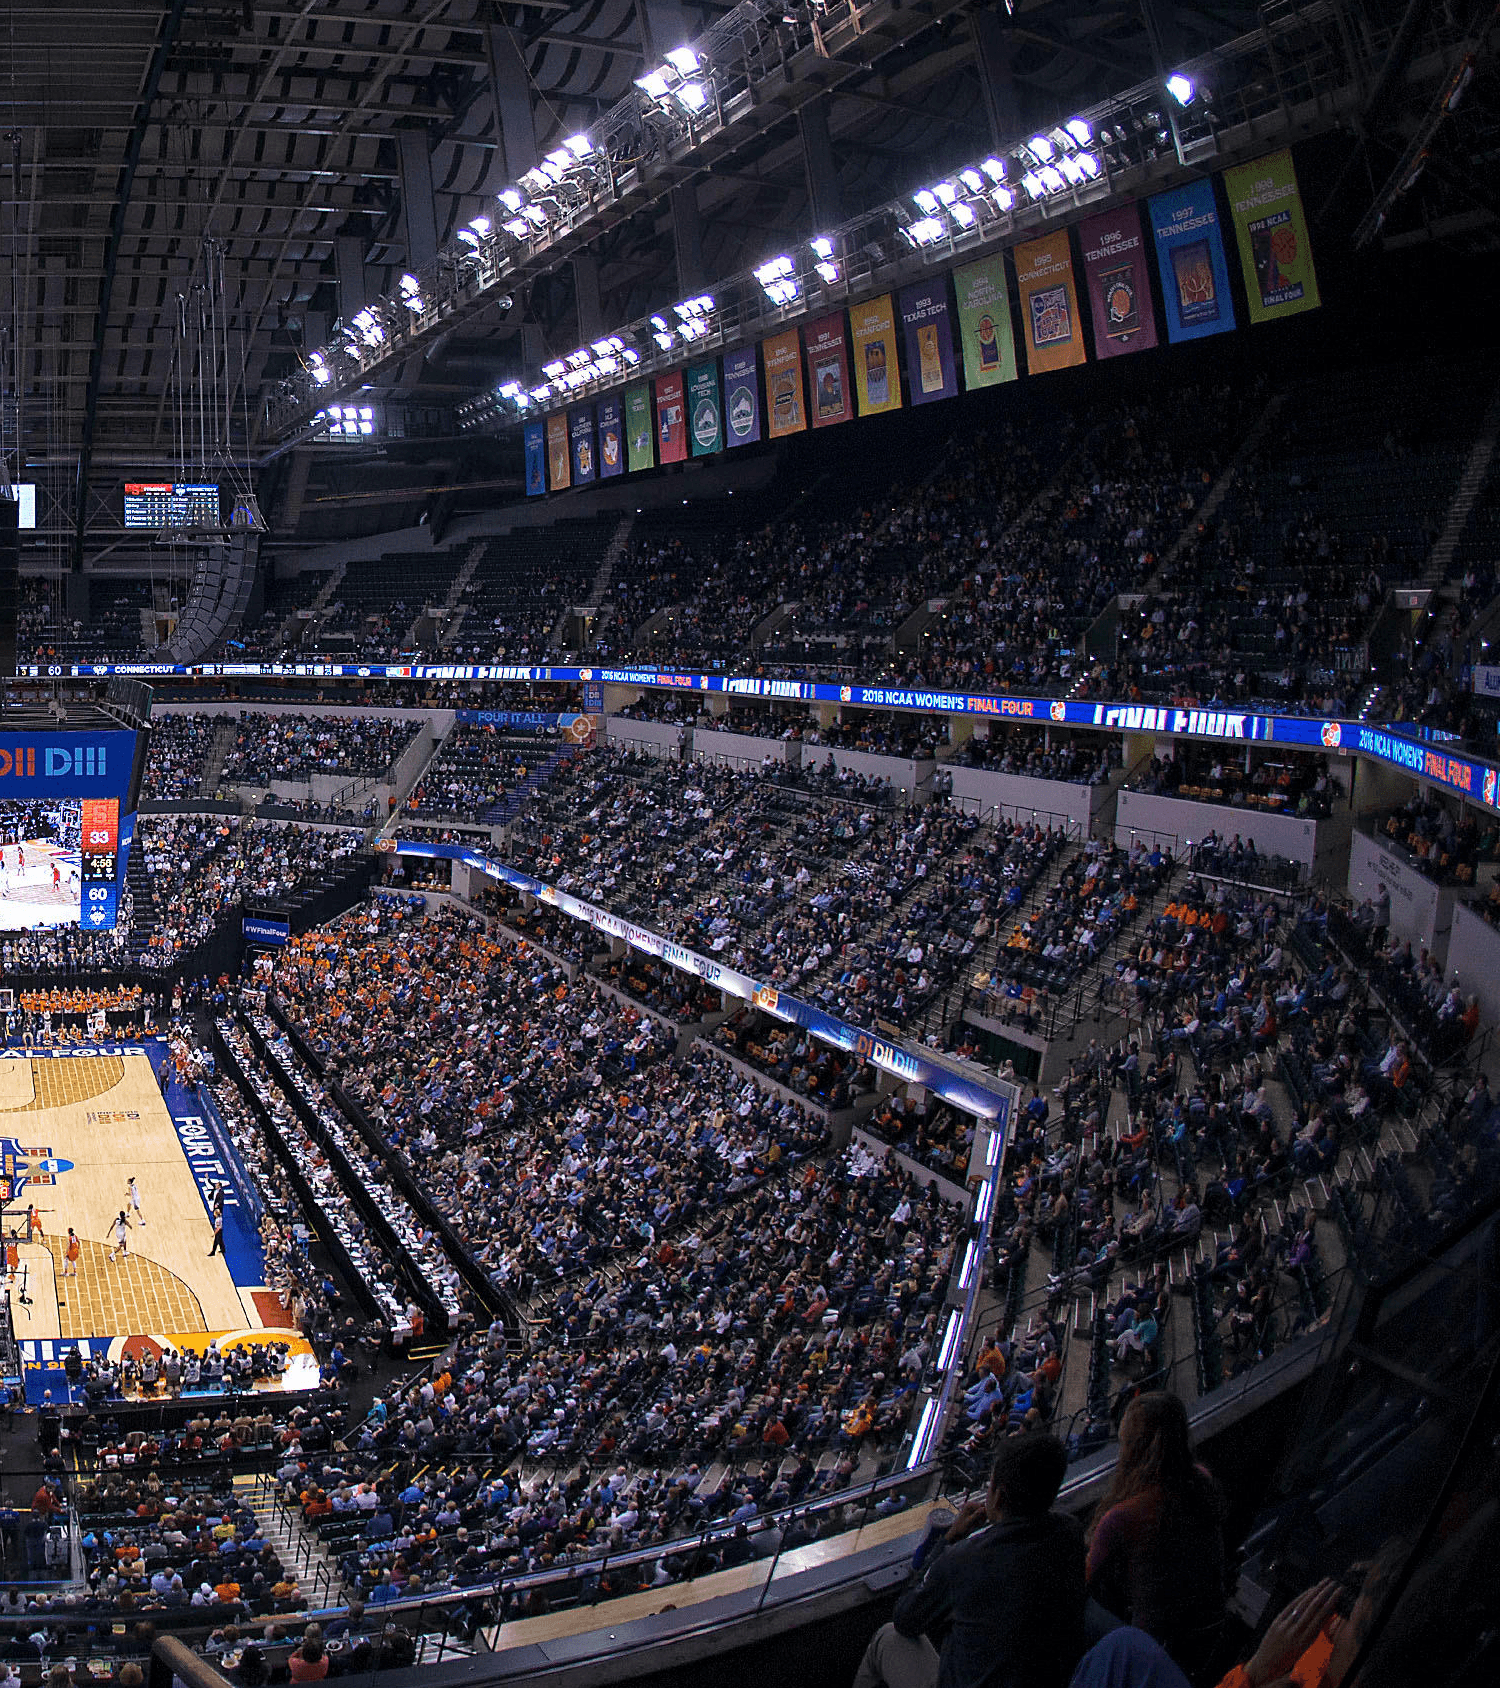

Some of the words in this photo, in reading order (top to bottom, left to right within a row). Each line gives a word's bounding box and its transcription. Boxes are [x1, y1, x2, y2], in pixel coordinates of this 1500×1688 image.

[1235, 184, 1296, 212] TENNESSEE
[1172, 206, 1194, 222] 1997
[1267, 212, 1288, 228] NCAA
[1156, 212, 1215, 239] TENNESSEE
[1100, 231, 1122, 246] 1996
[1086, 236, 1140, 262] TENNESSEE
[1018, 260, 1070, 282] CONNECTICUT
[968, 286, 995, 299] NORTH
[904, 309, 927, 324] TEXAS
[927, 302, 947, 316] TECH
[856, 320, 890, 338] STANFORD
[806, 336, 842, 354] TENNESSEE
[768, 352, 797, 368] STANFORD
[48, 666, 61, 676] 60
[114, 666, 174, 674] CONNECTICUT
[602, 670, 613, 680] 2016
[614, 671, 628, 681] NCAA
[629, 673, 656, 684] WOMEN'S
[656, 674, 675, 685] FINAL
[675, 676, 692, 686] FOUR
[862, 690, 884, 703] 2016
[886, 692, 913, 705] NCAA
[914, 694, 964, 710] WOMEN'S
[967, 698, 1000, 714] FINAL
[1002, 701, 1033, 716] FOUR
[478, 712, 508, 722] FOUR
[510, 712, 523, 723] IT
[524, 714, 545, 724] ALL
[45, 747, 106, 776] DIII
[1359, 729, 1374, 751] 2016
[1374, 734, 1391, 758] NCAA
[1392, 739, 1423, 771] WOMEN'S
[1425, 752, 1447, 781] FINAL
[1448, 760, 1471, 791] FOUR
[90, 831, 110, 844] 33
[88, 888, 107, 900] 60
[245, 925, 287, 937] #WFinalFour
[620, 924, 661, 950] WOMEN'S
[662, 943, 689, 964] FINAL
[694, 958, 721, 981] FOUR
[52, 1047, 146, 1058] FOUR
[858, 1035, 873, 1057] DI
[872, 1042, 893, 1067] DII
[175, 1116, 215, 1157] FOUR
[192, 1160, 225, 1175] IT
[198, 1177, 240, 1212] ALL
